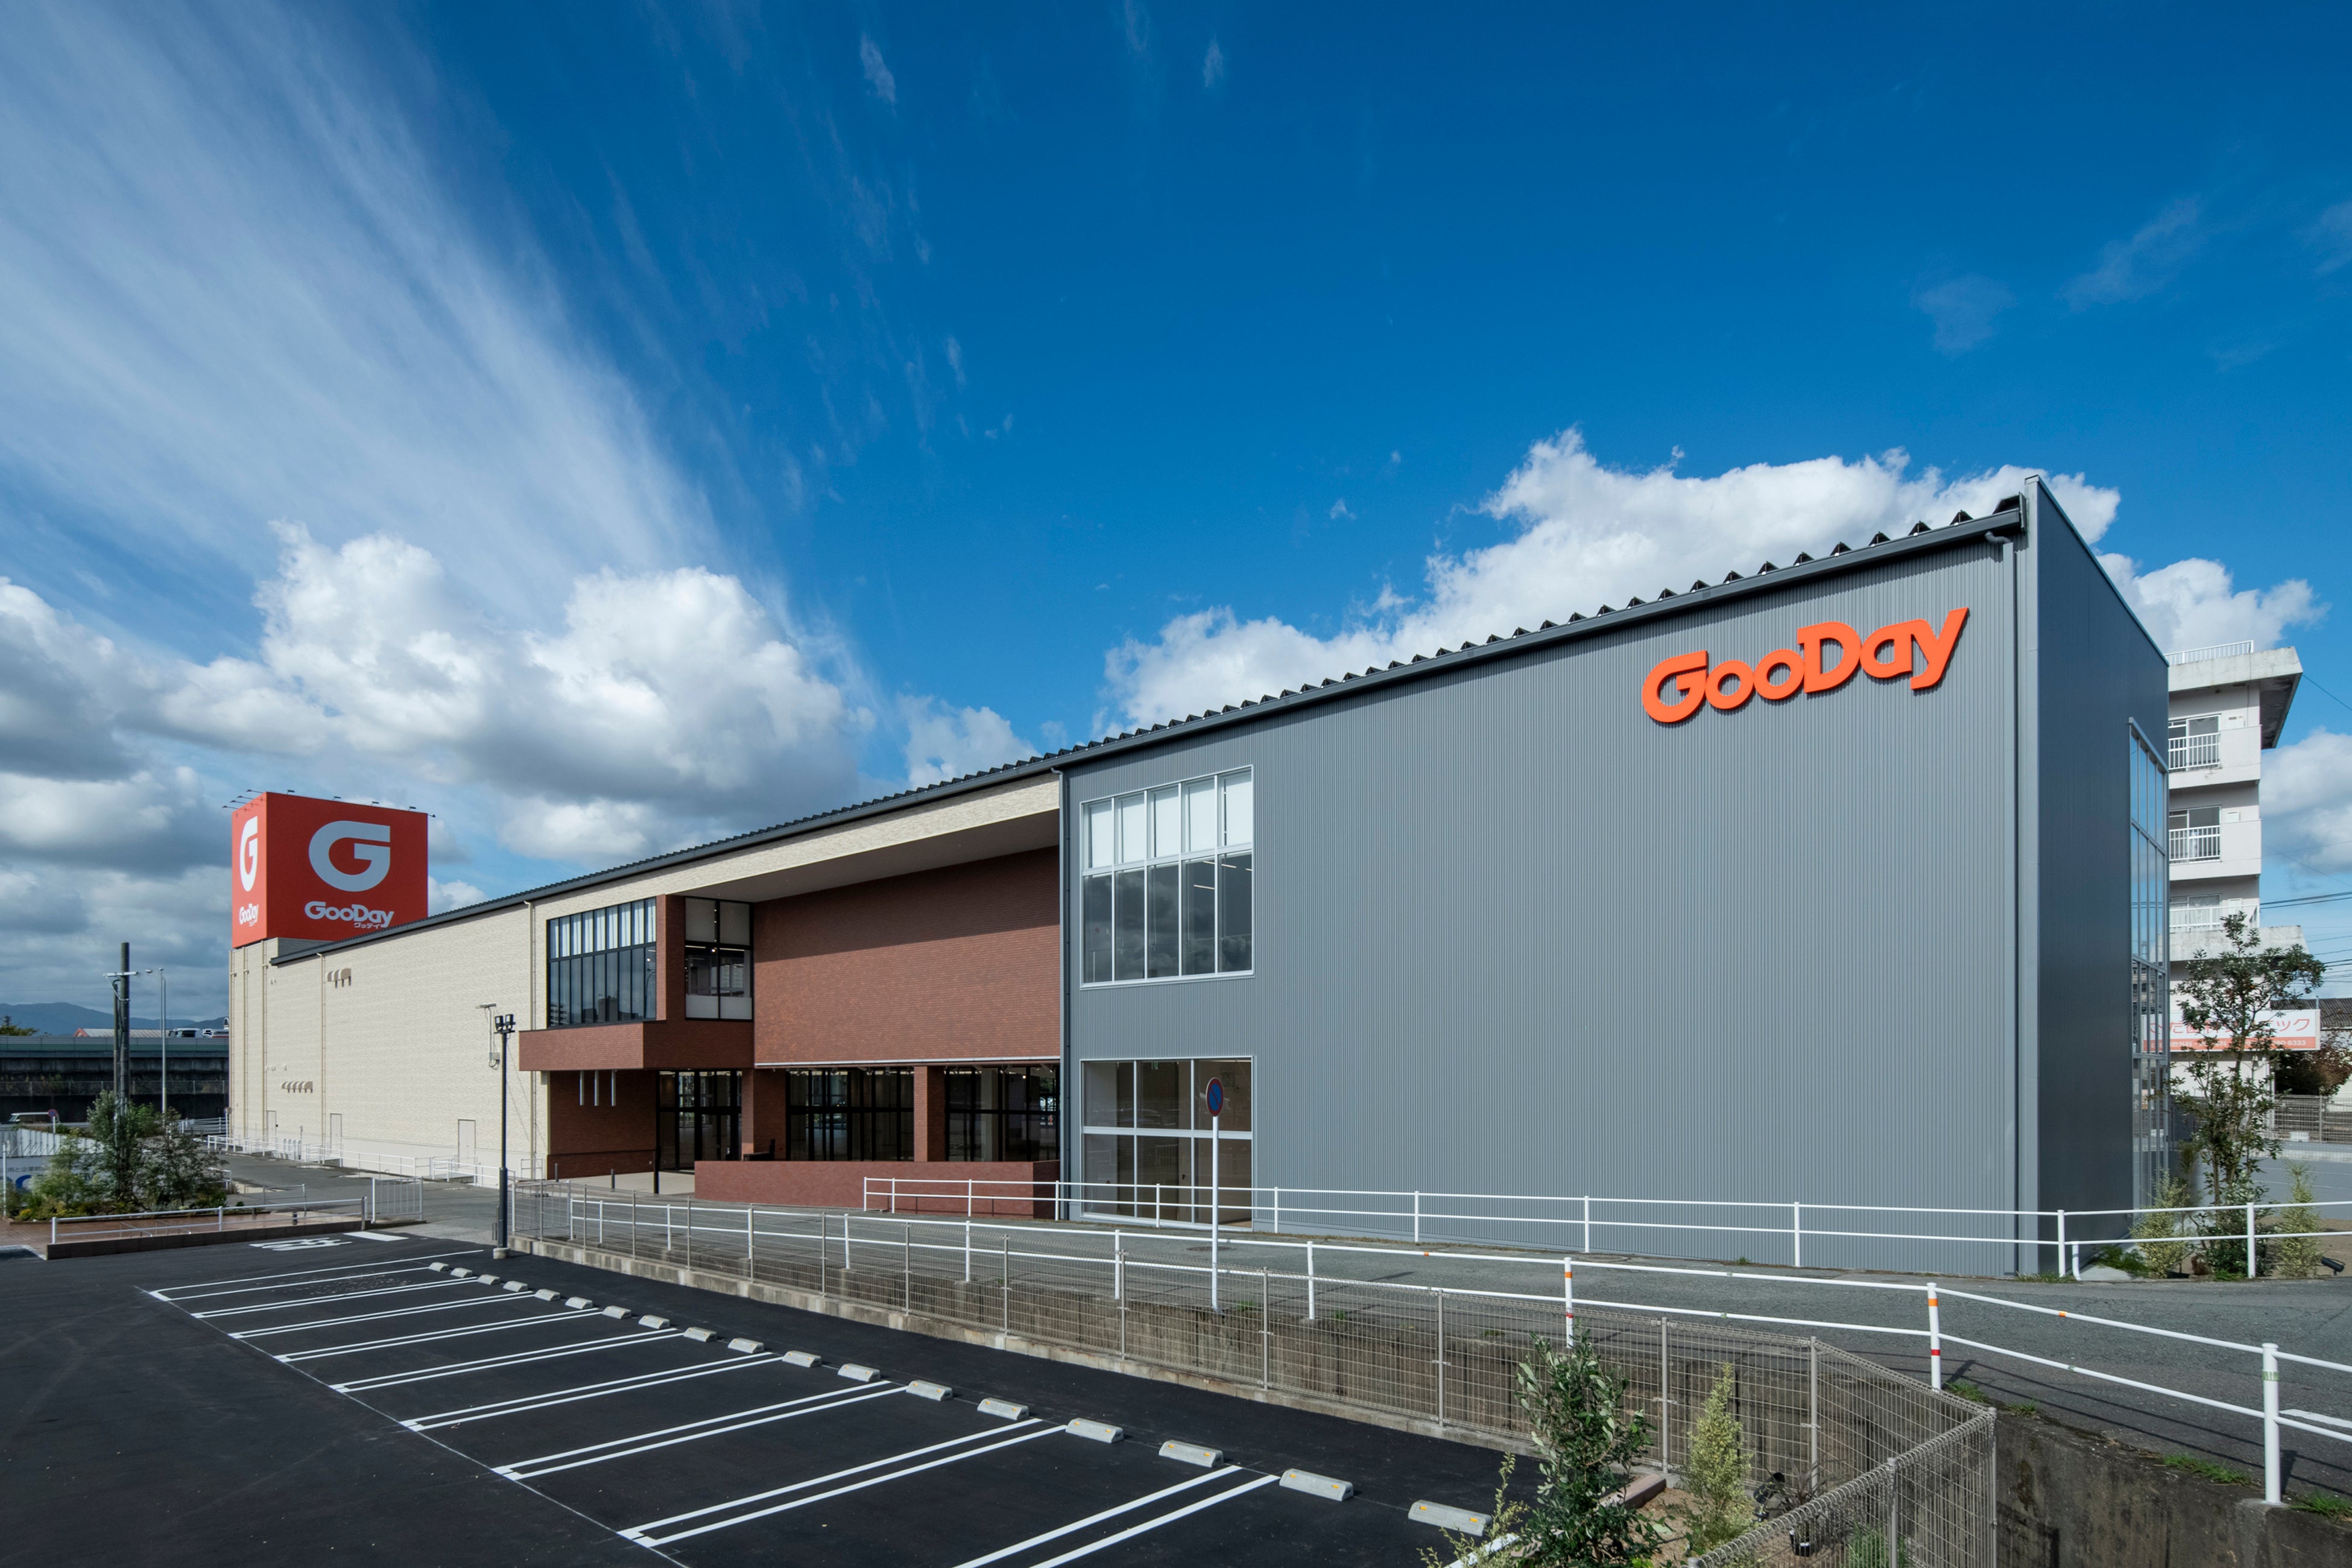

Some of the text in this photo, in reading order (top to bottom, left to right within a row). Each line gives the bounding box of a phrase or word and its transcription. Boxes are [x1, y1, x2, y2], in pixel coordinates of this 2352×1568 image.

[1641, 607, 1970, 723] GooDay
[239, 815, 258, 892] G
[308, 820, 391, 892] G
[305, 900, 394, 928] GooDay
